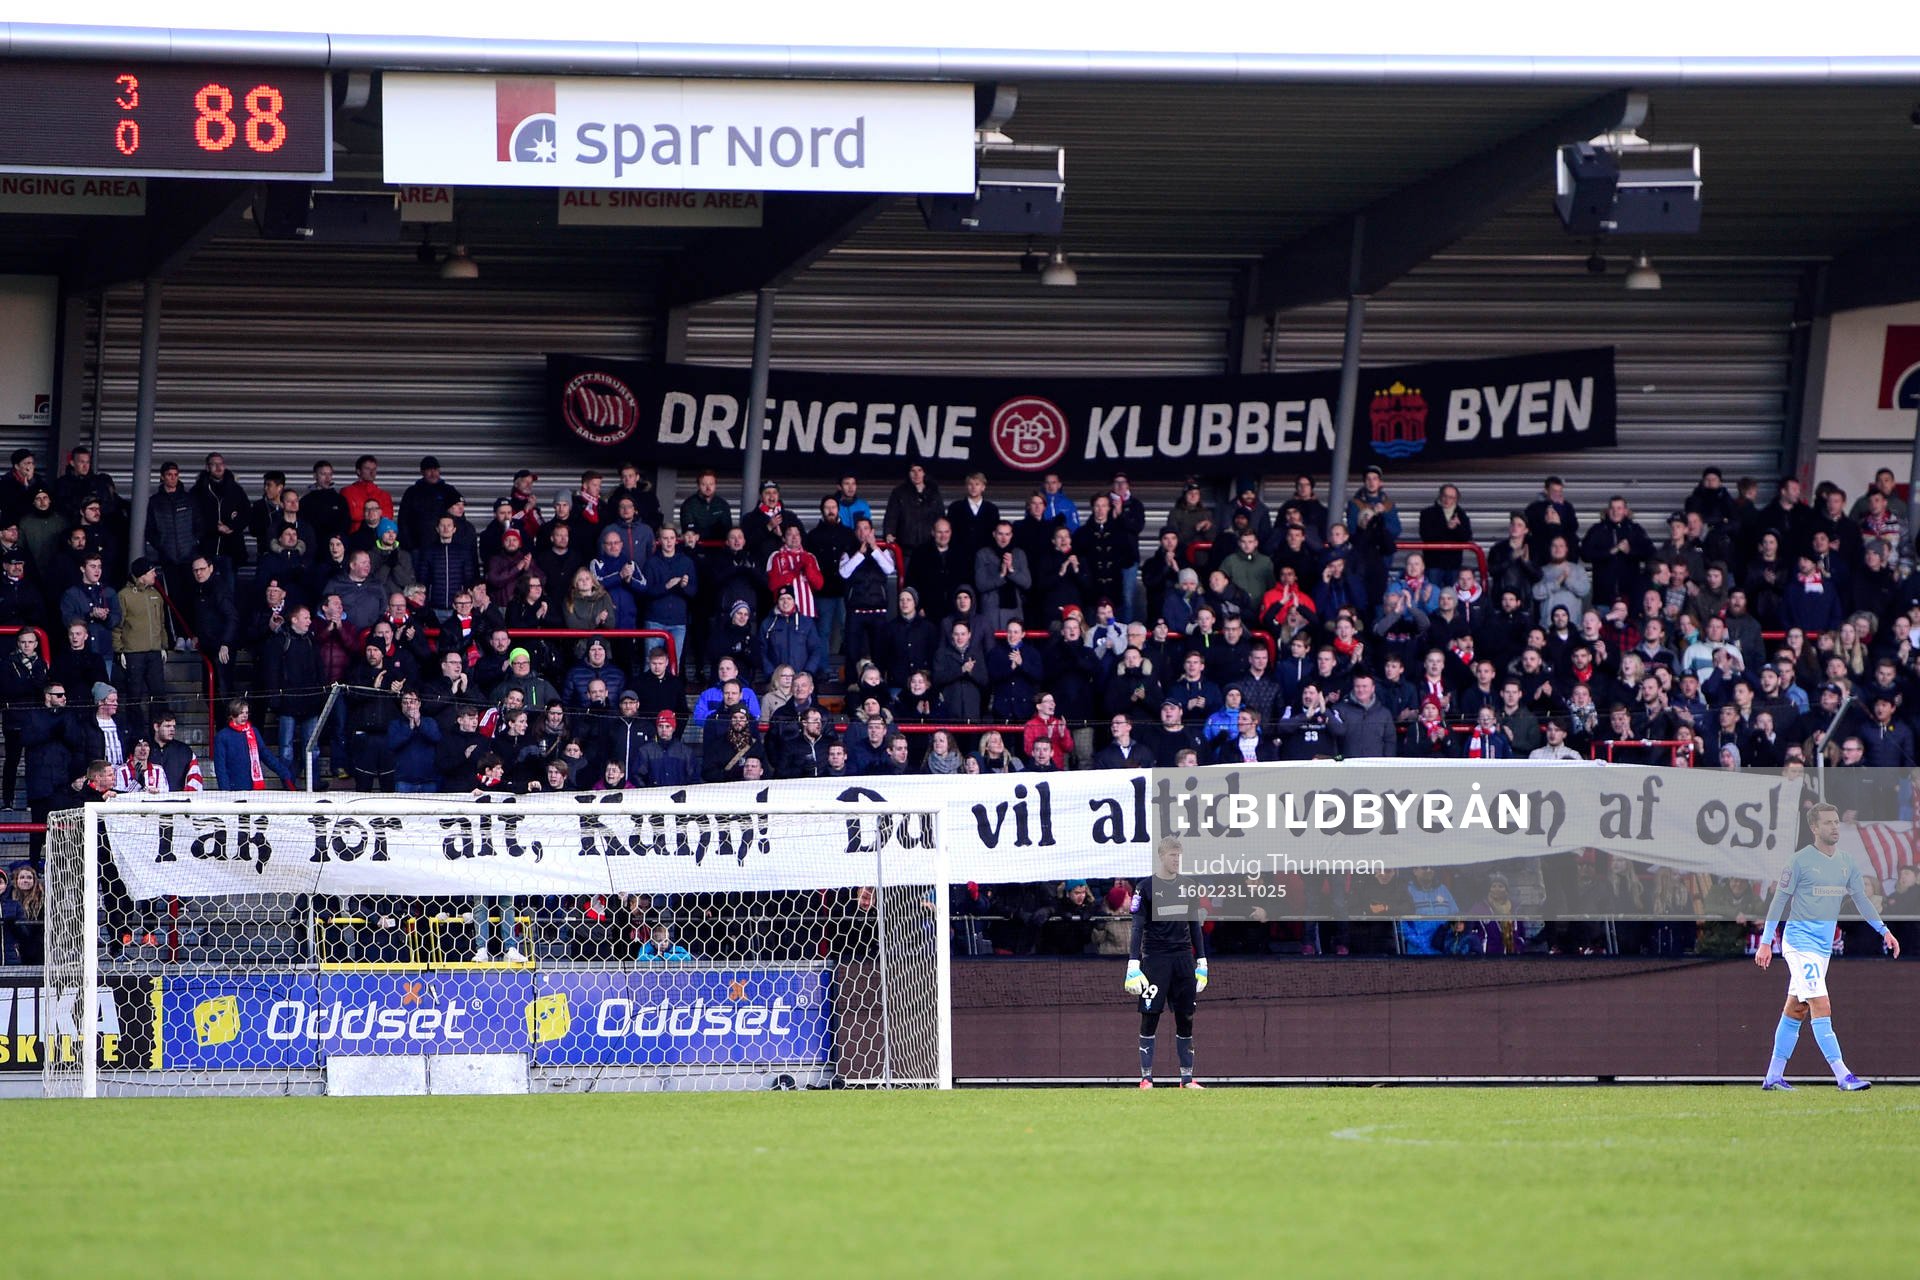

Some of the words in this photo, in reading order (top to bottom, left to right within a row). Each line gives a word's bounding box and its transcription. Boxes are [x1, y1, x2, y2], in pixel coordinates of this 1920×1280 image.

[116, 74, 140, 110] 3
[194, 84, 286, 152] 88
[116, 119, 140, 155] 0
[575, 121, 714, 178] spar
[2, 177, 76, 196] NGING
[83, 179, 141, 197] AREA
[563, 190, 602, 207] ALL
[608, 190, 696, 208] SINGING
[703, 191, 759, 209] AREA
[1084, 397, 1336, 460] KLUBBEN
[1444, 376, 1594, 442] BYEN
[1304, 731, 1319, 742] 33
[971, 780, 1057, 849] vil
[1089, 771, 1246, 845] altid
[1600, 774, 1664, 841] af
[1696, 781, 1783, 851] os!
[1803, 962, 1820, 980] 21
[266, 999, 467, 1041] Oddset
[595, 996, 792, 1037] Oddset
[0, 1033, 119, 1063] SKILE
